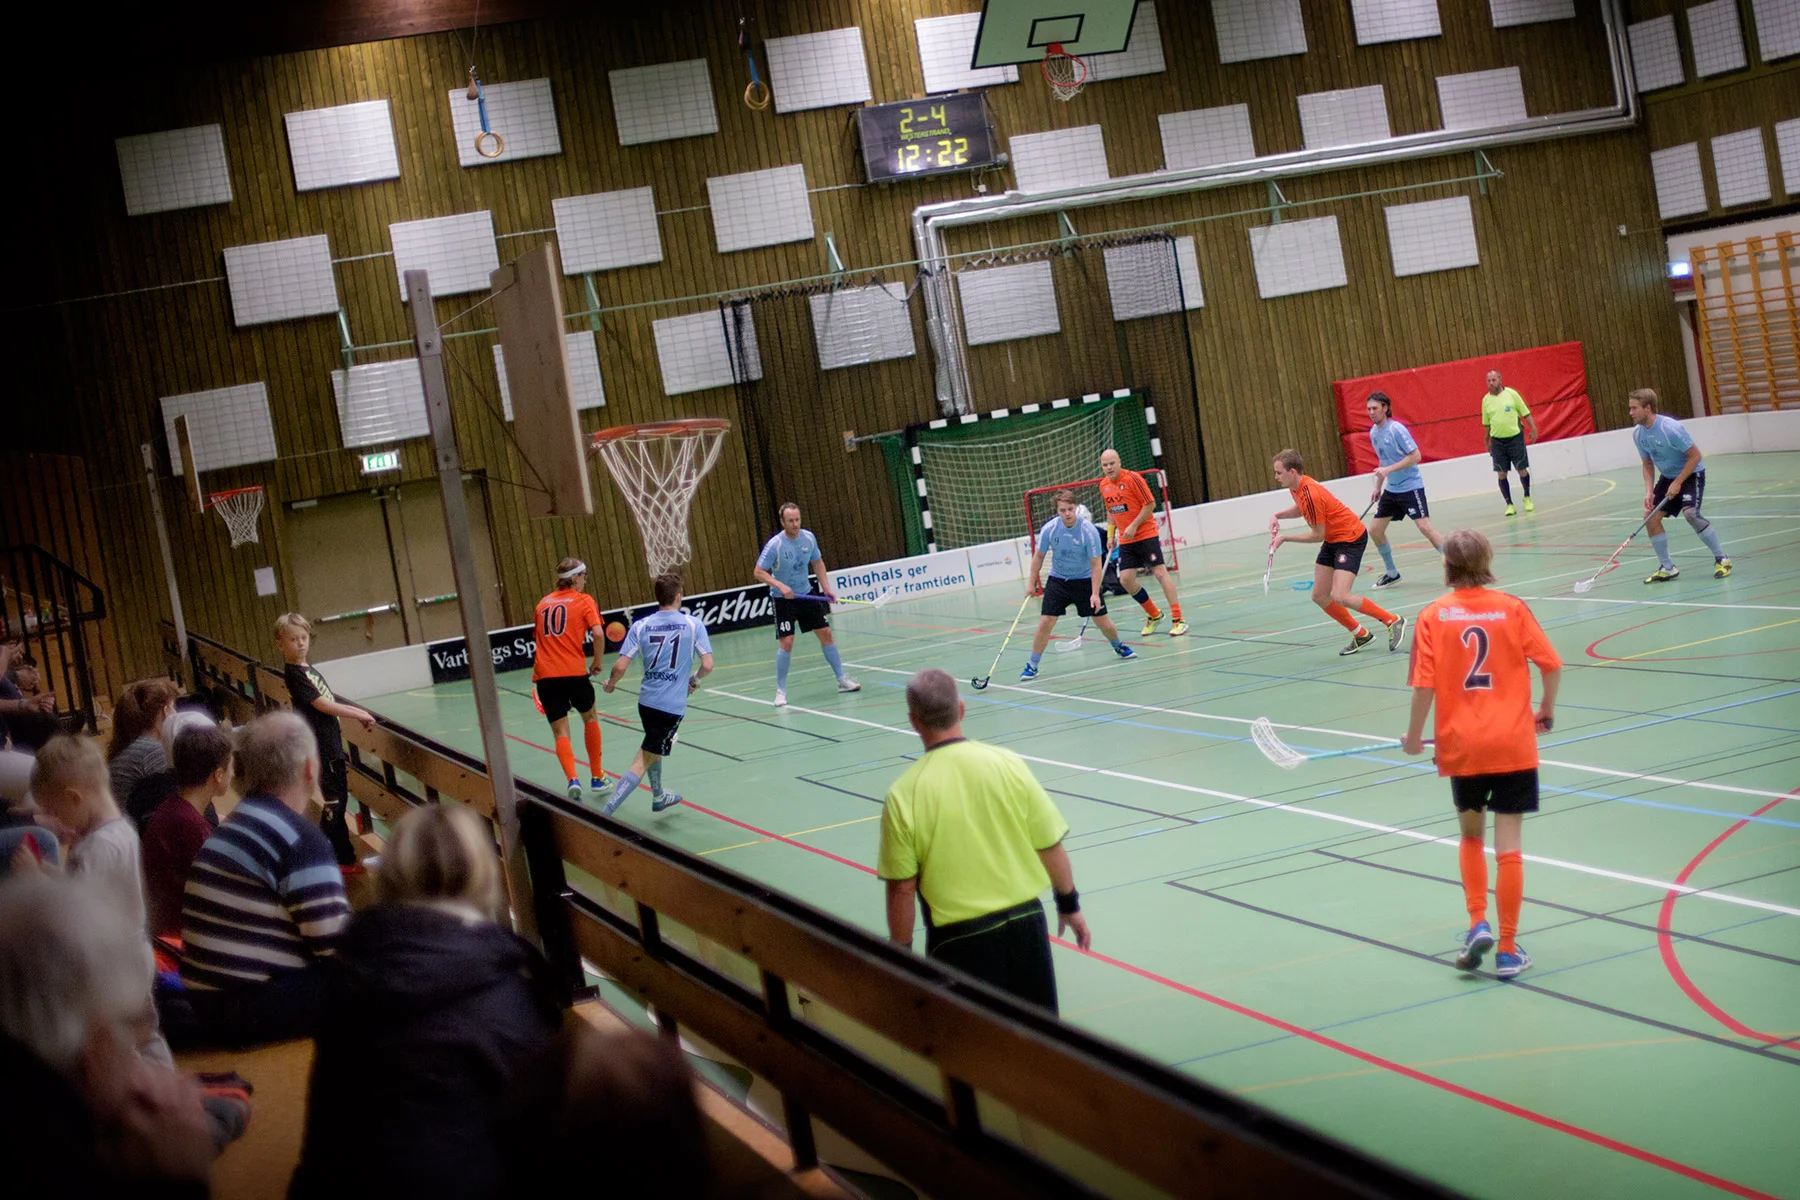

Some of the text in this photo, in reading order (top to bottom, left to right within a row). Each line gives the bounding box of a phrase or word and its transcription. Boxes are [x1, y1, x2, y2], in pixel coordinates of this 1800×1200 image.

[900, 104, 946, 134] 2-4
[897, 137, 969, 171] 12:22
[836, 564, 928, 589] Ringhals ger
[904, 574, 966, 593] framtiden
[541, 604, 567, 637] 10
[780, 620, 791, 633] 40
[648, 632, 681, 671] 71
[1460, 625, 1493, 690] 2
